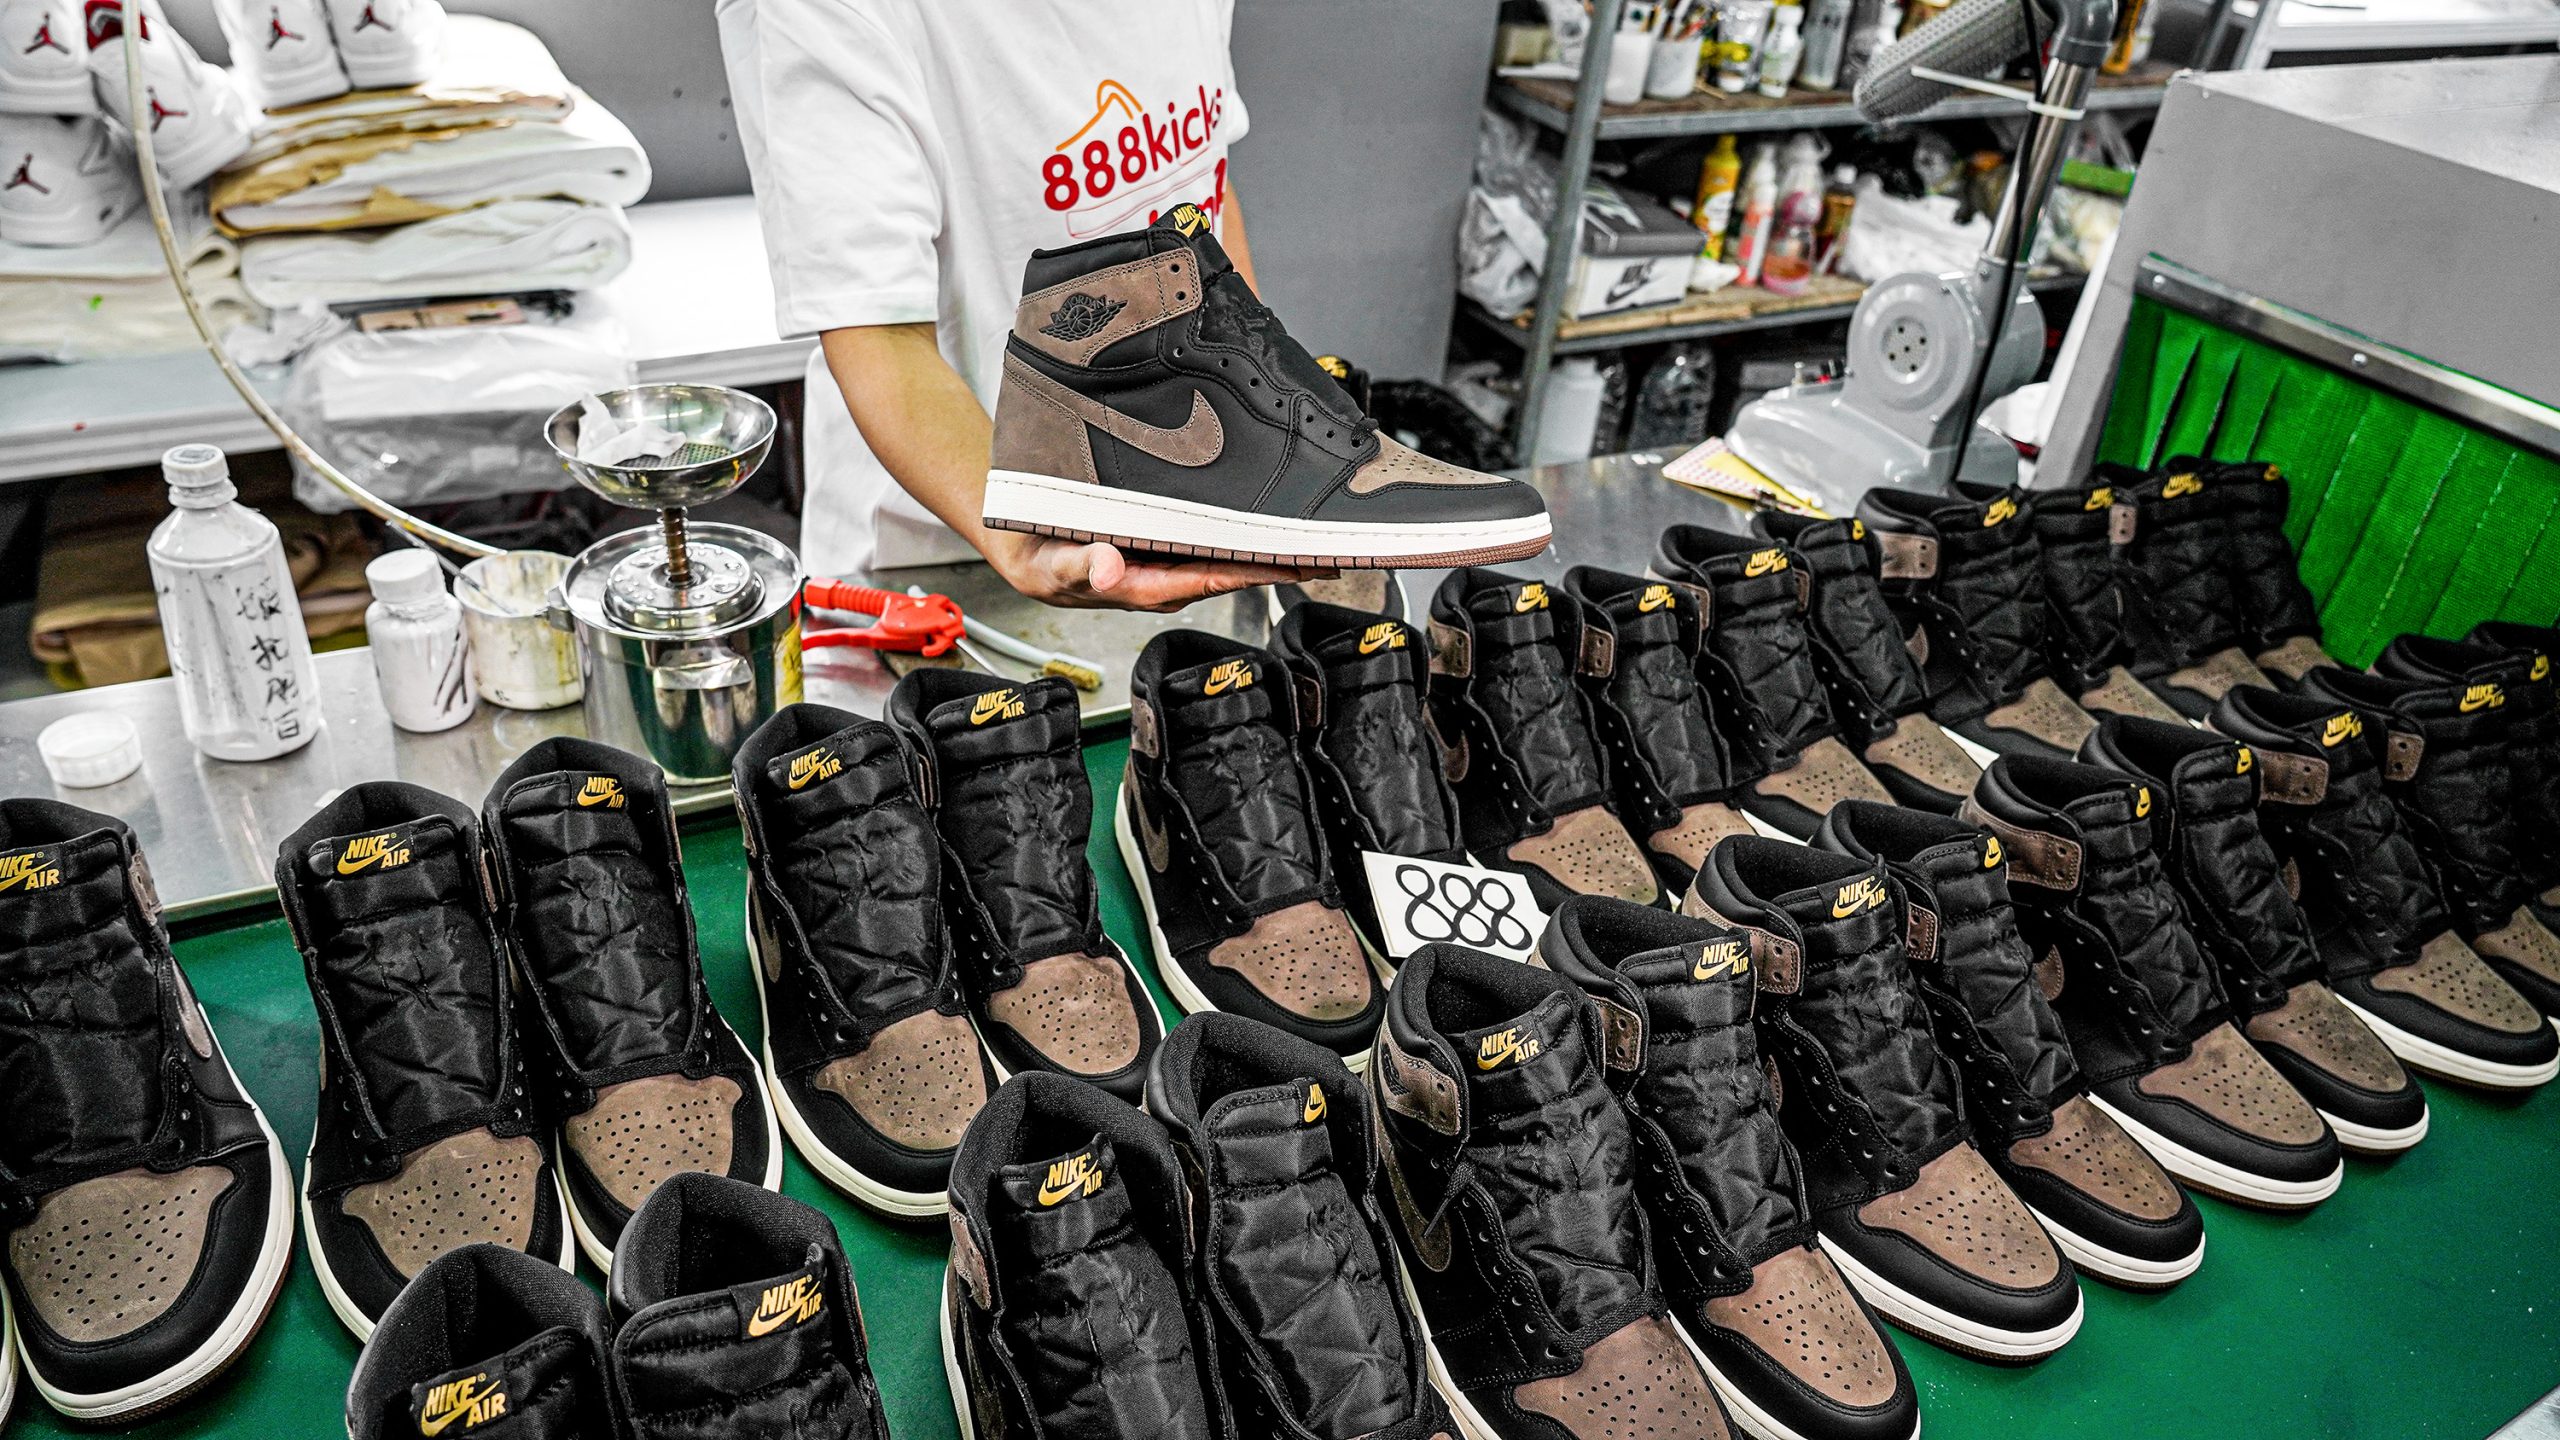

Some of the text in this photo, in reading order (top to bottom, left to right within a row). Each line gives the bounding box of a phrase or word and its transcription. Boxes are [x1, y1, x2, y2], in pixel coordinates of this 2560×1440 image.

[1750, 549, 1777, 568] NIKE
[1365, 622, 1395, 642] NIKE
[1389, 634, 1406, 648] AIR
[1210, 660, 1241, 684] NIKE
[1235, 671, 1253, 689] AIR
[976, 689, 1008, 713] NIKE
[2466, 683, 2494, 702] NIKE
[1002, 701, 1025, 720] AIR
[791, 749, 820, 778] NIKE
[819, 758, 843, 781] AIR
[587, 777, 616, 794] NIKE
[607, 794, 625, 808] AIR
[346, 834, 390, 860] NIKE
[380, 848, 410, 869] AIR
[0, 853, 36, 879] IKE
[25, 869, 60, 891] AIR
[1838, 878, 1871, 906] NIKE
[1395, 864, 1533, 951] 888
[1868, 887, 1885, 910] AIR
[1701, 941, 1737, 966] NIKE
[1731, 956, 1749, 975] AIR
[1482, 1027, 1516, 1057] NIKE
[1515, 1039, 1540, 1063] AIR
[1047, 1154, 1087, 1189] NIKE
[1083, 1170, 1102, 1197] AIR
[760, 1277, 807, 1318] NIKE
[796, 1292, 822, 1324] AIR
[426, 1376, 477, 1418] NIKE
[466, 1392, 506, 1428] AIR
